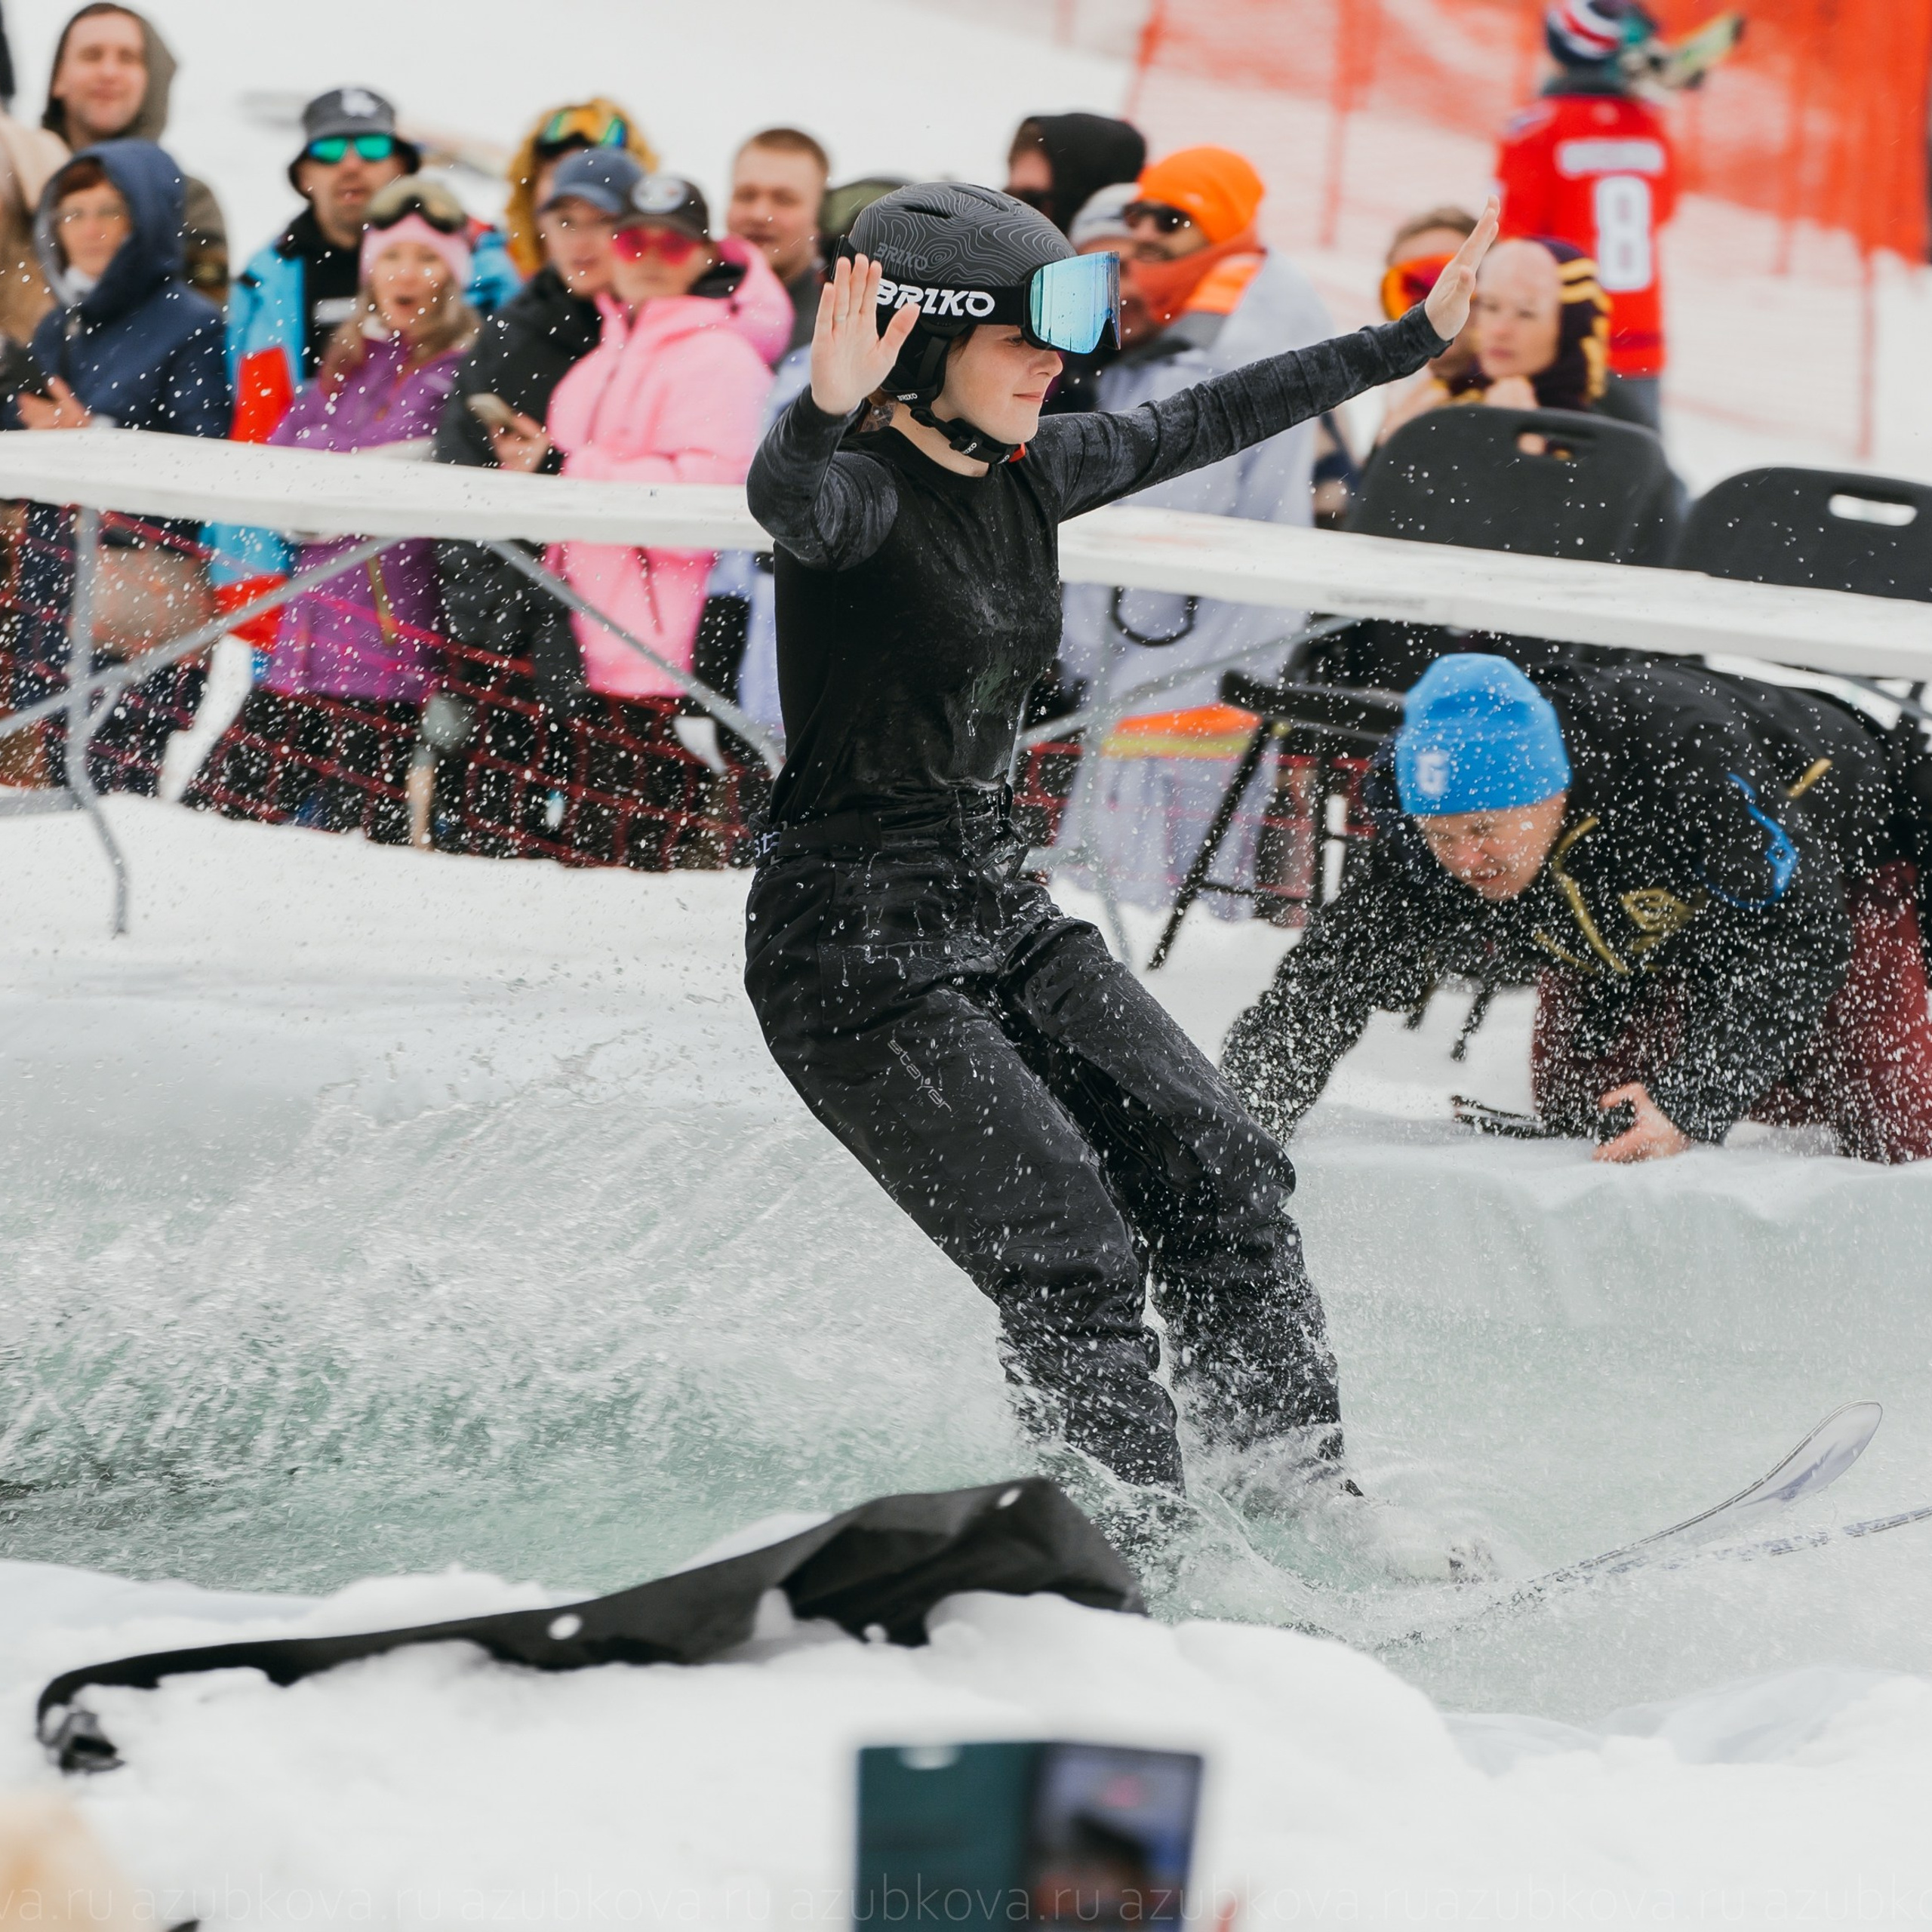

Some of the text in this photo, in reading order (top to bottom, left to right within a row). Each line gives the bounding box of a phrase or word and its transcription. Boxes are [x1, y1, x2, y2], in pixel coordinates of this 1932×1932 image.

[873, 242, 928, 271] BRIKO
[1595, 175, 1651, 291] 8
[876, 278, 995, 318] BRIKO
[888, 1040, 952, 1112] stayer
